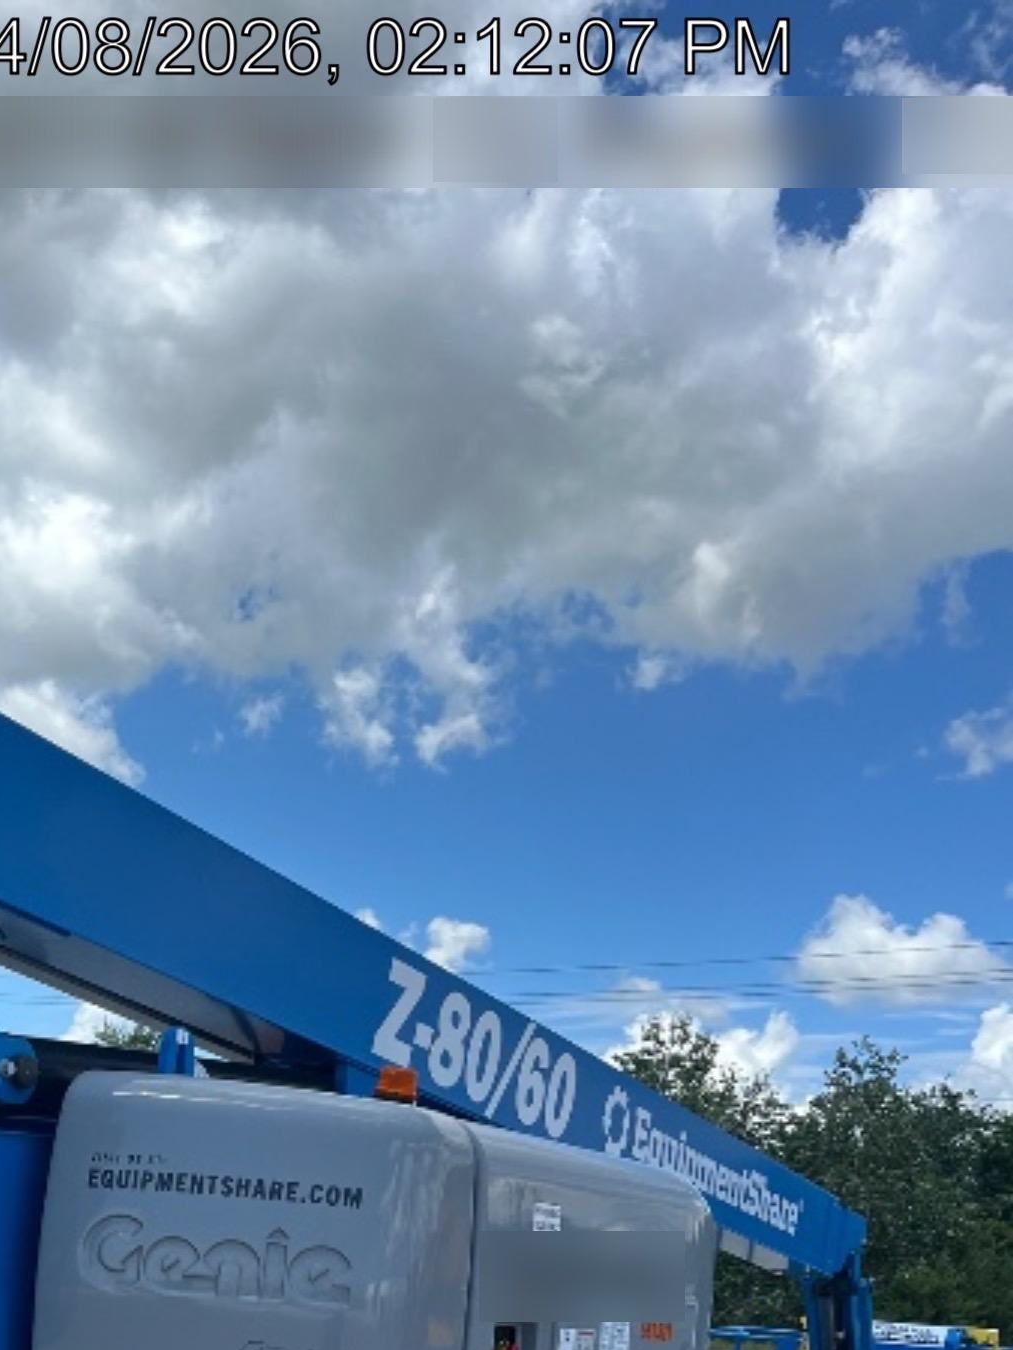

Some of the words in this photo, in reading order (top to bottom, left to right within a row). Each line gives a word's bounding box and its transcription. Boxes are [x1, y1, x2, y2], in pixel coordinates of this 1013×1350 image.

[371, 957, 576, 1138] Z-80/60
[87, 1167, 364, 1209] EQUIPMENTSHARE.COM
[632, 1106, 799, 1236] EquipmentShare
[82, 1213, 353, 1303] Genie
